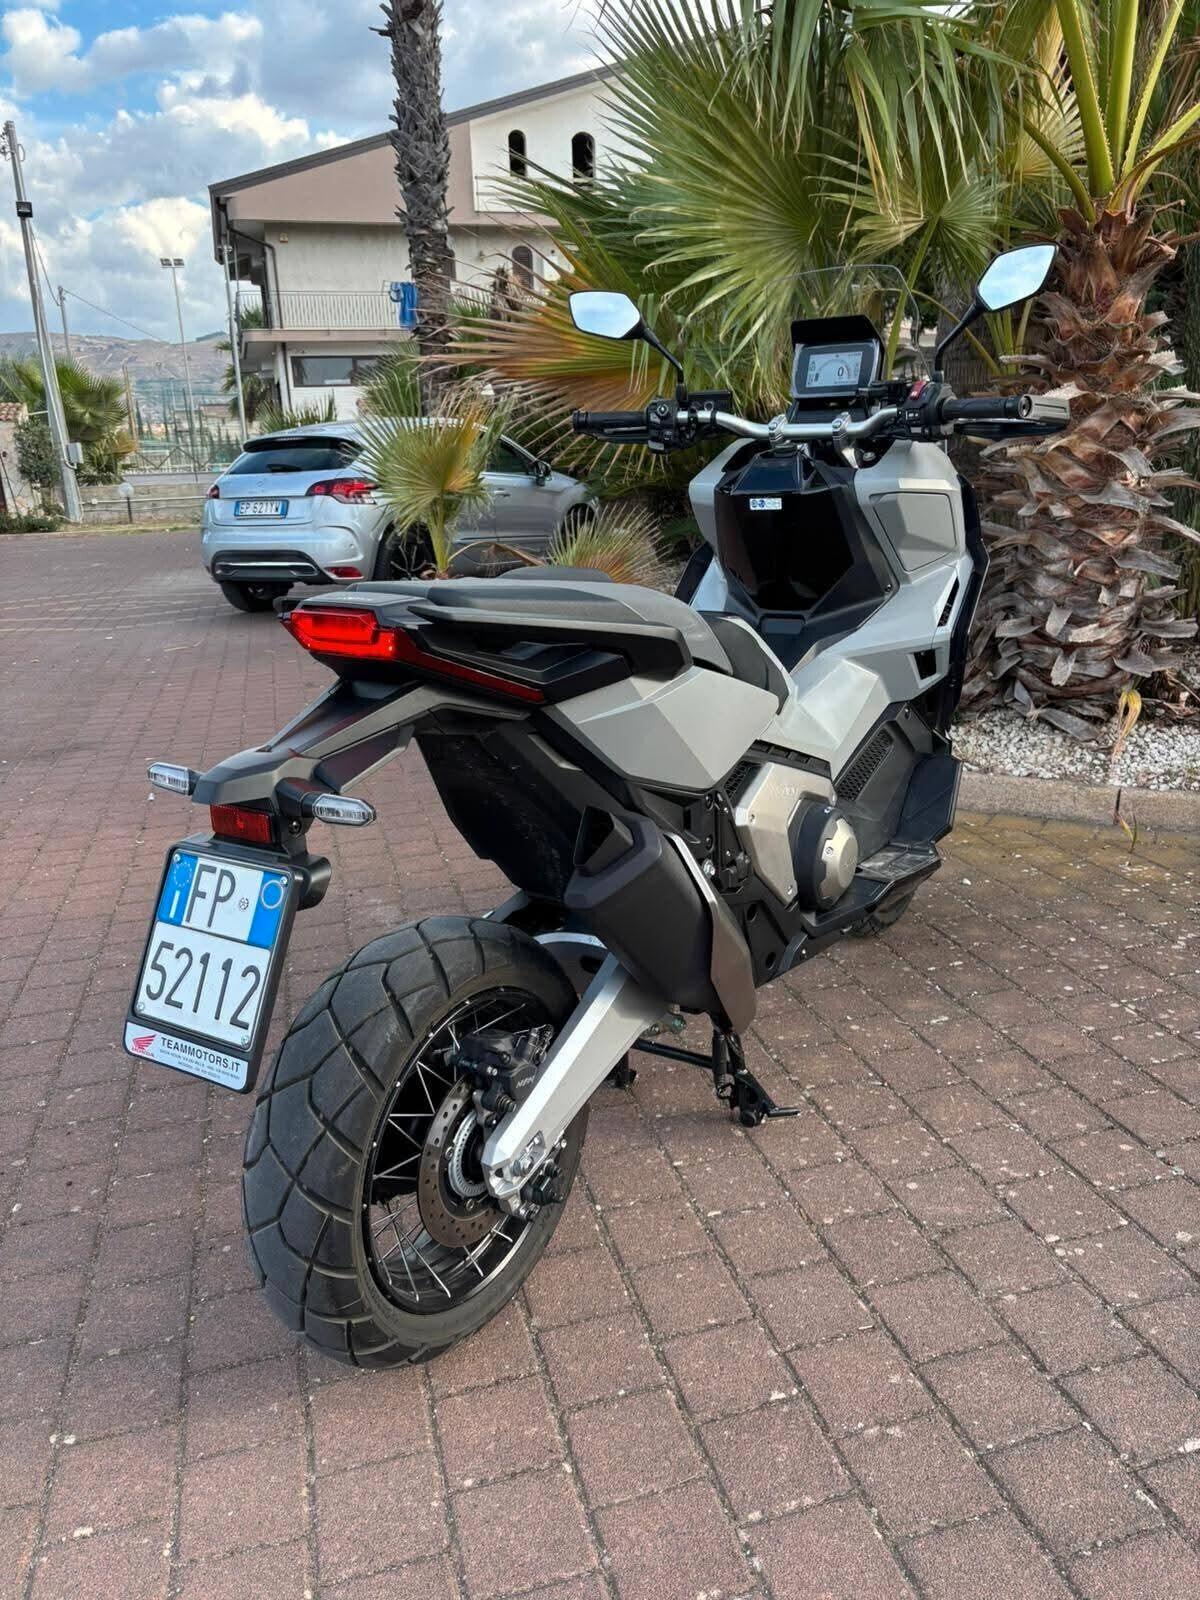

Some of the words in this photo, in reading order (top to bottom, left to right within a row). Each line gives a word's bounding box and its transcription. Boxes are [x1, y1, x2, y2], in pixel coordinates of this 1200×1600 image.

[837, 366, 845, 377] 0
[240, 502, 250, 514] EP
[169, 891, 181, 919] I
[185, 863, 236, 928] FP
[145, 941, 261, 1031] 52112
[160, 1036, 241, 1073] TEAMMOTORS.IT
